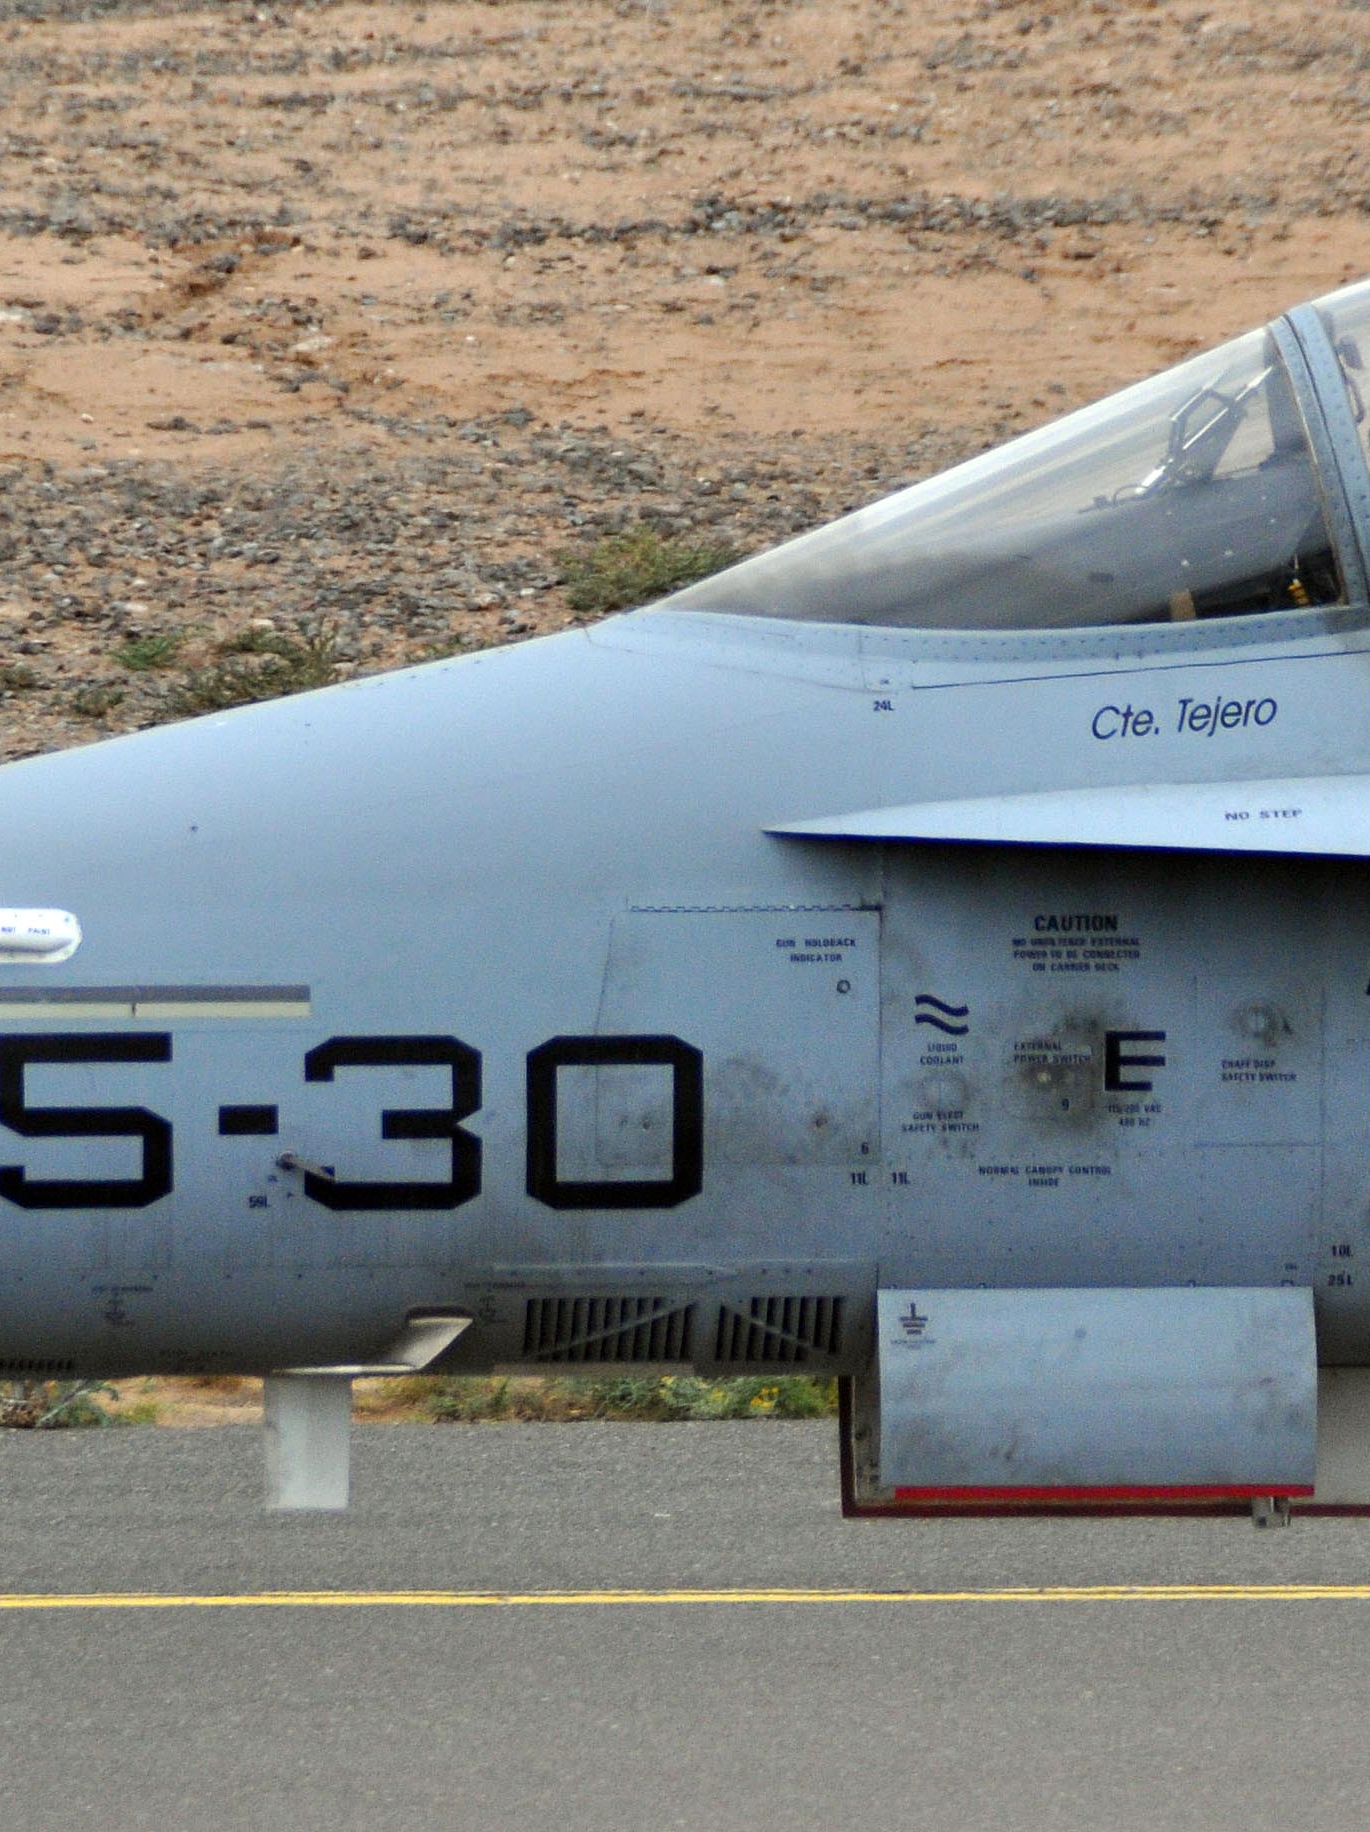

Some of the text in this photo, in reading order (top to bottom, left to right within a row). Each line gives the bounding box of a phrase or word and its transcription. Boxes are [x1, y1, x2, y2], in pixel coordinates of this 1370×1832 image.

[873, 700, 894, 711] 24L
[1092, 696, 1278, 740] Cte. Tejero
[1224, 809, 1302, 821] NO STEP
[1034, 914, 1119, 932] CAUTION
[790, 953, 843, 962] INDICATOR
[927, 1043, 958, 1052] LIQUID
[1014, 1041, 1063, 1051] EXTERNAL
[919, 1056, 964, 1066] COOLANT
[1013, 1054, 1091, 1064] POWER SWITCH
[1105, 1031, 1166, 1091] E
[1062, 1098, 1070, 1111] 9
[913, 1111, 933, 1121] GUN
[901, 1123, 979, 1132] SAFETY SWITCH
[978, 1166, 1111, 1175] NORMAL CANOPY CONTROL
